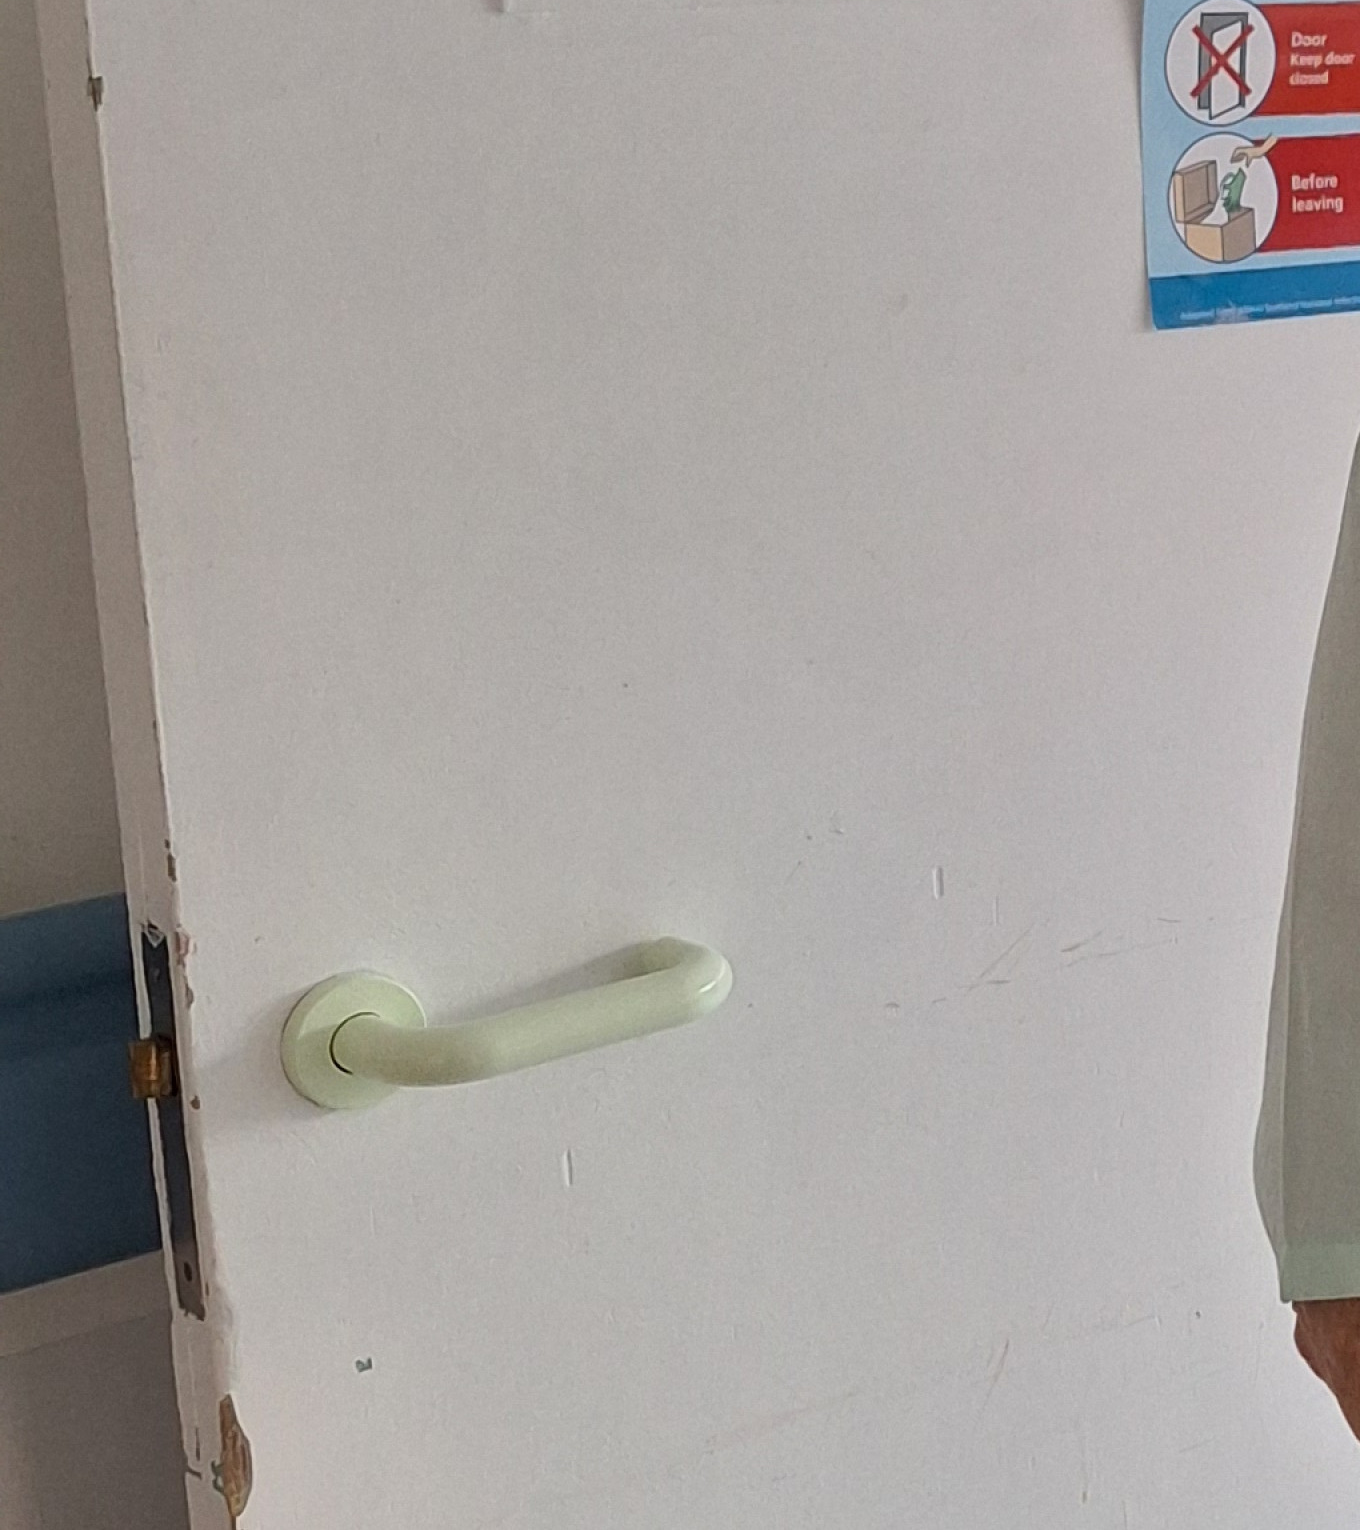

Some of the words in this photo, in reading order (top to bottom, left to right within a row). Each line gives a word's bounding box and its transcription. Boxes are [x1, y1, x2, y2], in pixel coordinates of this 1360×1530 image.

[1291, 31, 1328, 48] Door
[1290, 54, 1323, 68] Keep
[1324, 51, 1356, 65] door
[1291, 172, 1338, 191] Before
[1292, 195, 1344, 213] leaving
